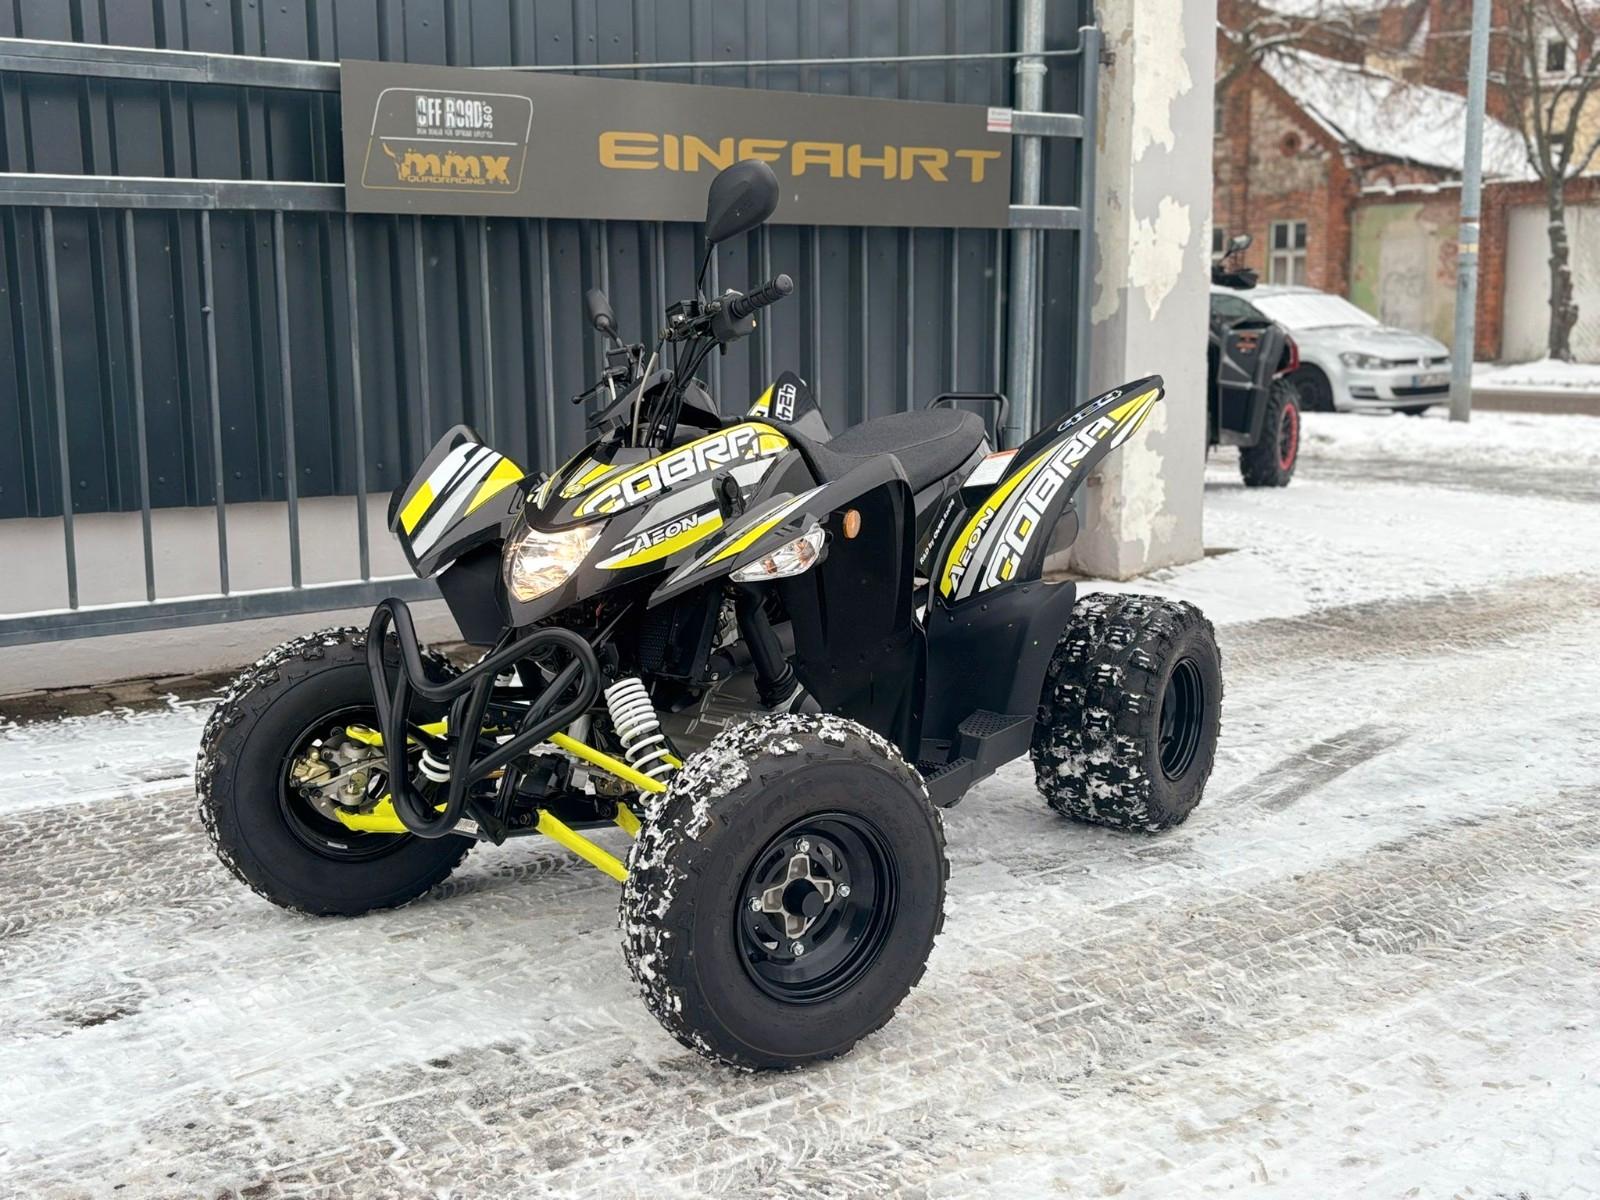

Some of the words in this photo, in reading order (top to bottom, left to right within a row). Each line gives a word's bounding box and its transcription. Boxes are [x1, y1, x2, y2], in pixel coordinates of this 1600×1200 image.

[416, 96, 442, 127] OFF
[445, 97, 483, 129] ROAD
[599, 131, 1001, 183] EINFAHRT
[776, 384, 796, 420] 424
[583, 425, 759, 515] COBRA
[986, 415, 1116, 588] COBRA
[629, 514, 699, 555] AEON
[948, 507, 997, 593] AEON
